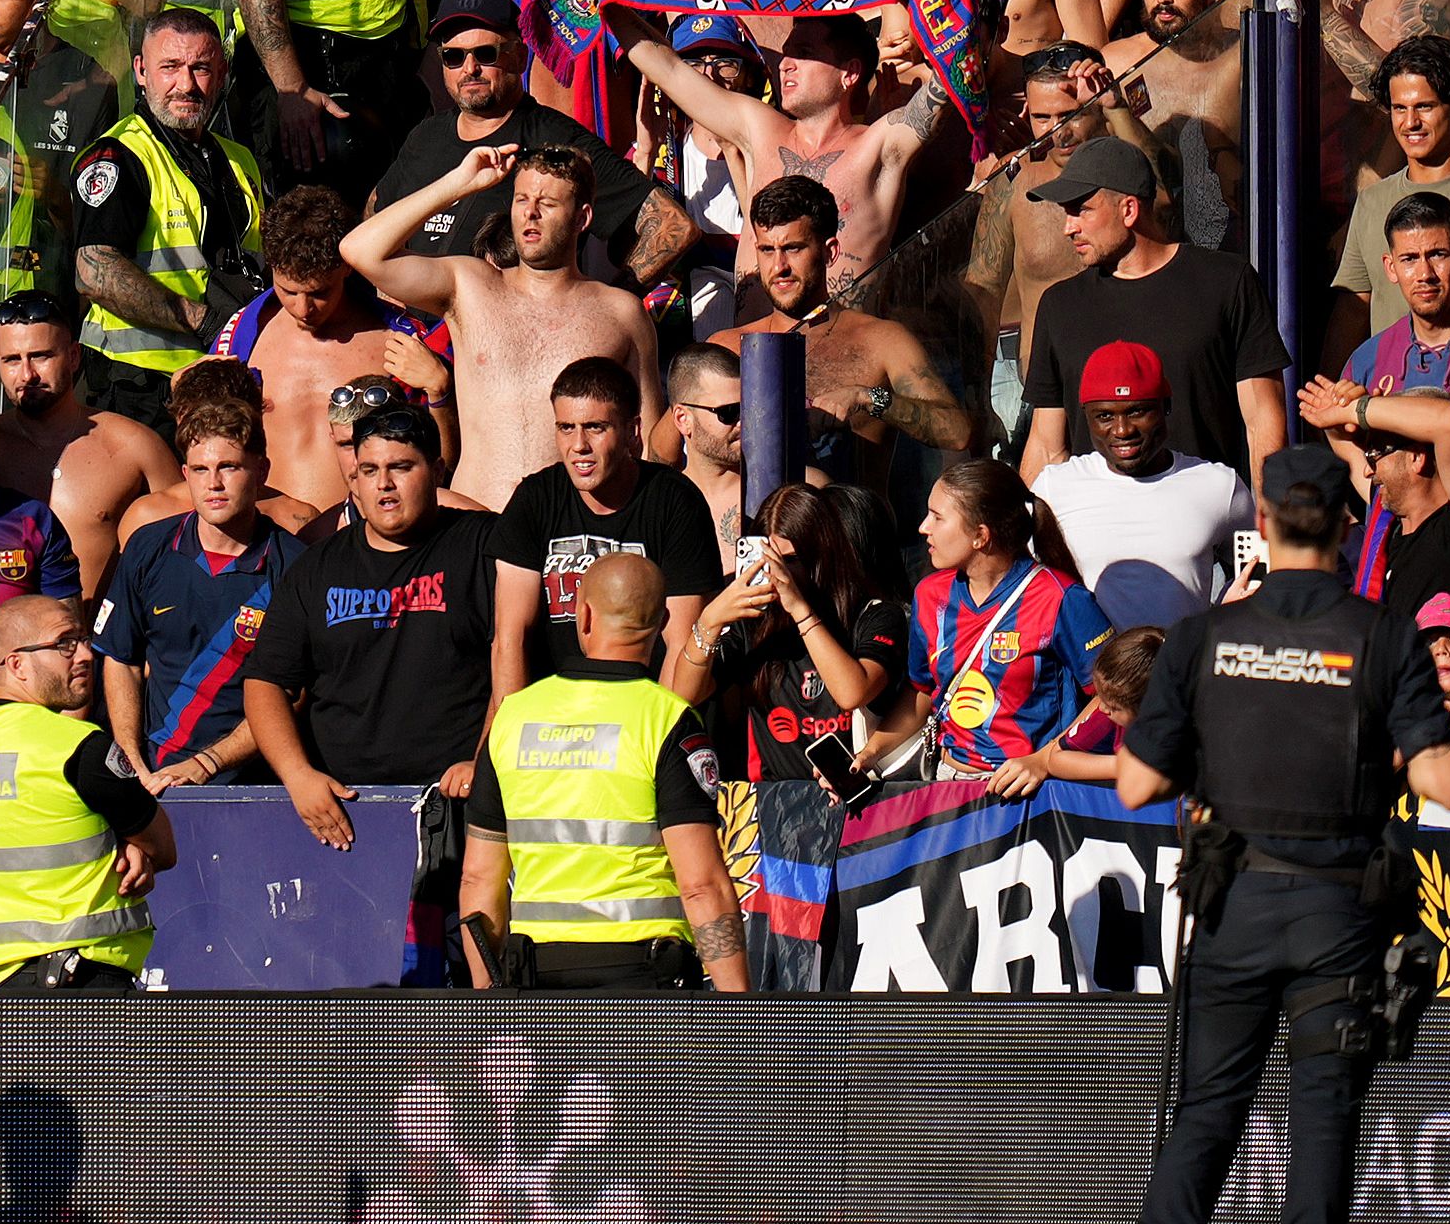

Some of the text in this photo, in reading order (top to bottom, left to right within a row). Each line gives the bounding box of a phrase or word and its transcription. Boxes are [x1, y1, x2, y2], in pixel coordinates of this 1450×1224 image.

[1215, 643, 1326, 667] POLICIA
[1214, 659, 1351, 686] NACIONAL
[537, 726, 595, 743] GRUPO
[801, 713, 851, 737] Spoti
[519, 749, 613, 769] LEVANTINA
